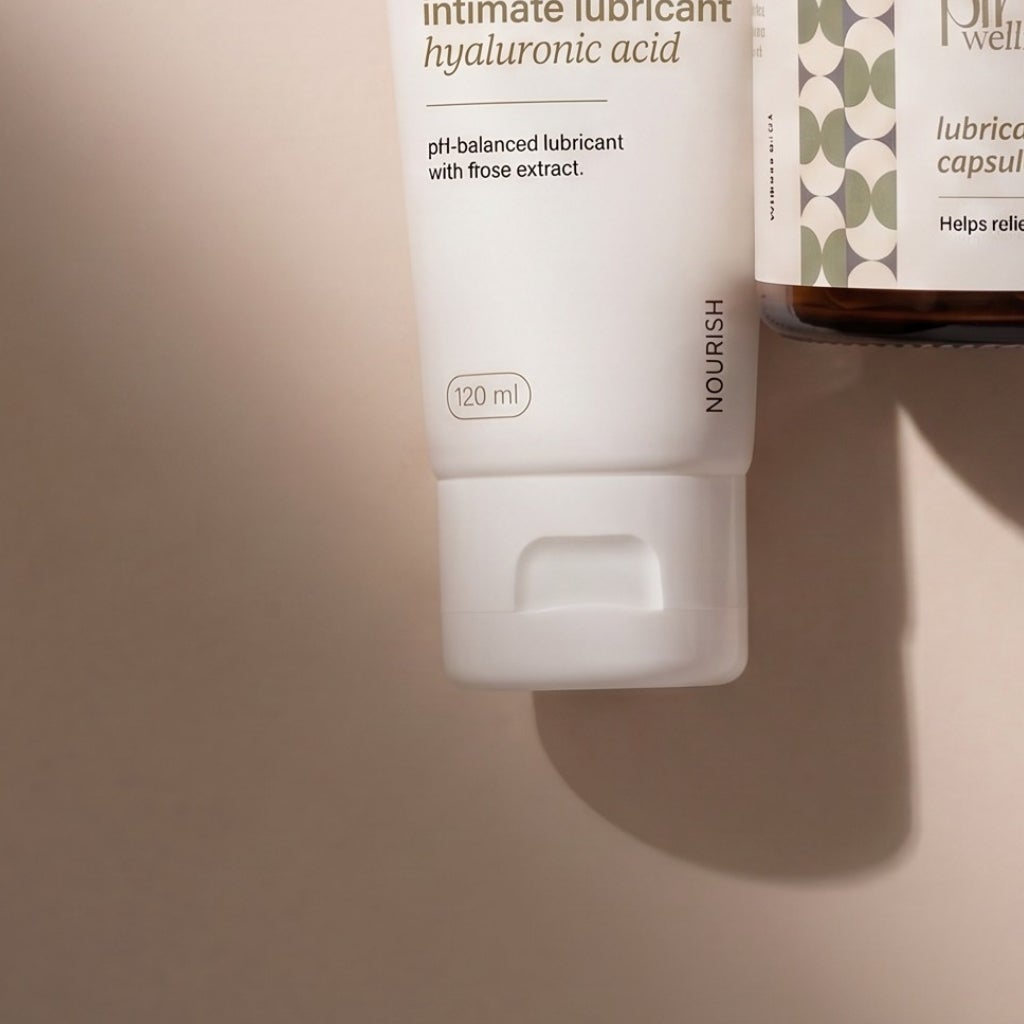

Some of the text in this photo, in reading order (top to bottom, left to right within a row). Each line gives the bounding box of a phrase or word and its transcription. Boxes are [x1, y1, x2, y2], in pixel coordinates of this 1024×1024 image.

[423, 30, 682, 77] hyaluronic acid
[428, 133, 625, 160] pH-balanced lubricant
[428, 162, 463, 180] with
[516, 159, 584, 178] extract.
[939, 215, 988, 236] Helps
[704, 298, 724, 414] NOURISH
[454, 382, 518, 407] 120 ml
